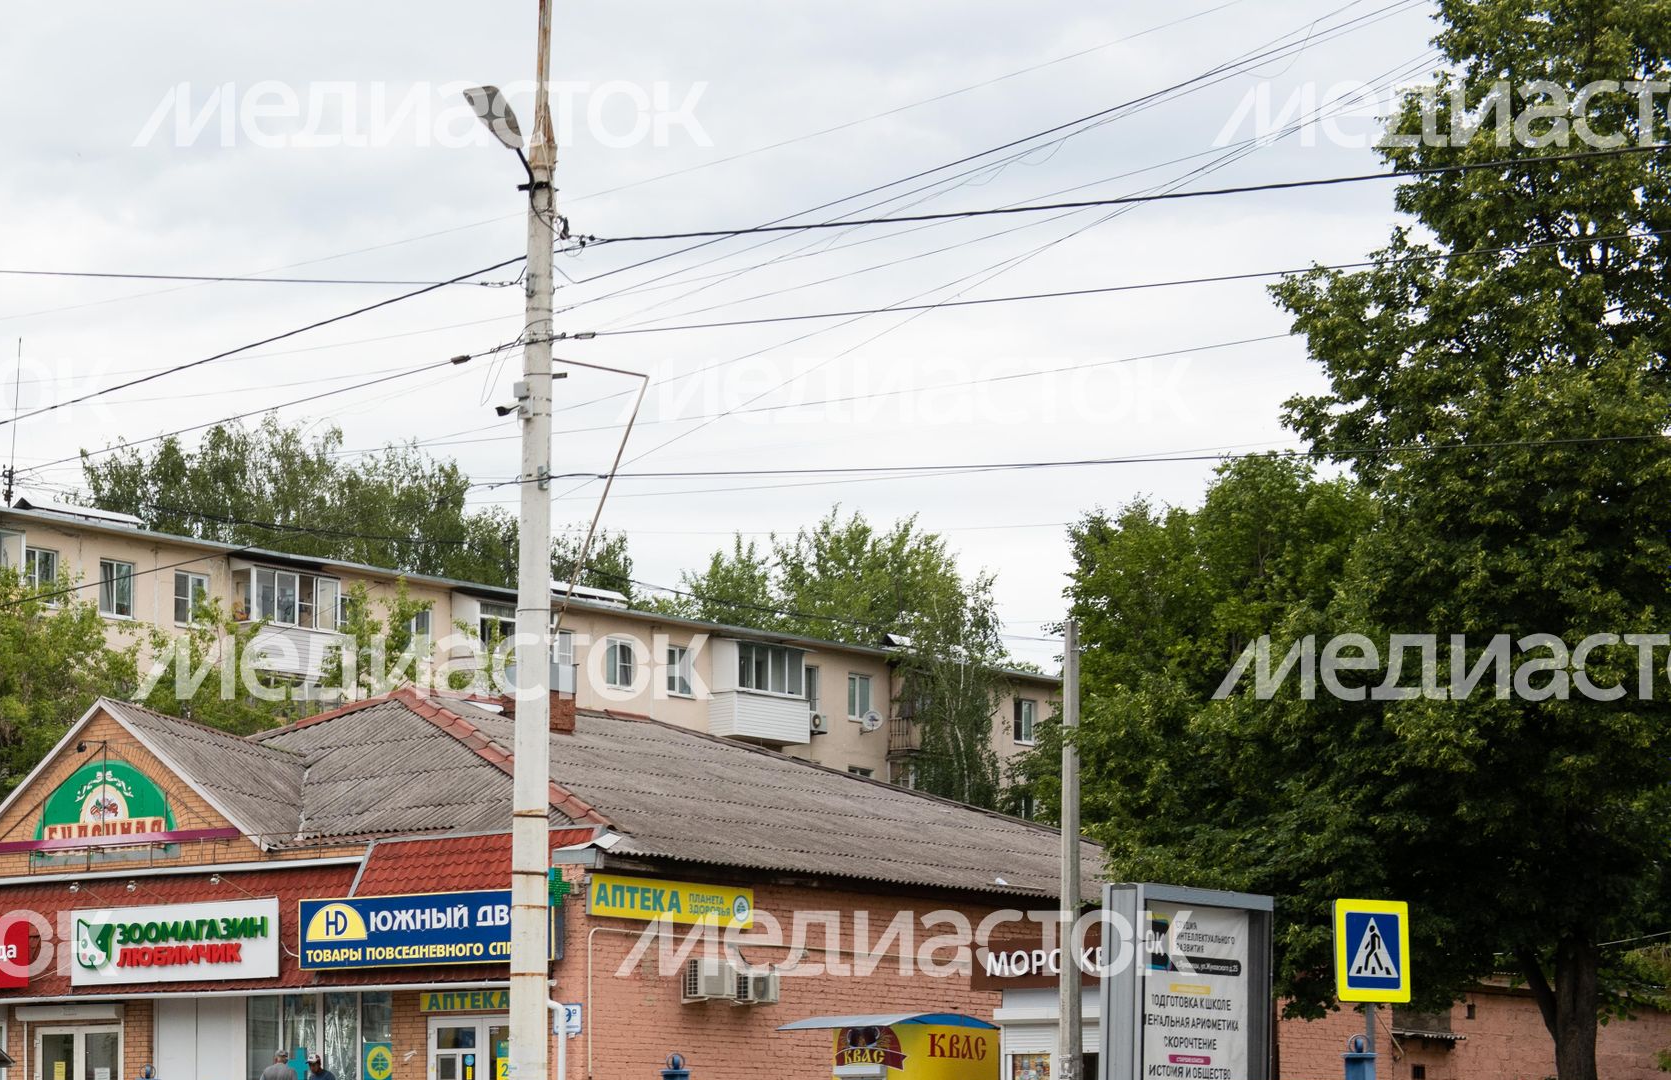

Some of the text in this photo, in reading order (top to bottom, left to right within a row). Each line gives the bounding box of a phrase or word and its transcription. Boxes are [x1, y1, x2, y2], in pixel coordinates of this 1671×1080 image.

[595, 883, 682, 914] АПТЕКА
[688, 893, 725, 906] ПЛАНЕТА
[369, 904, 512, 932] ЮЖНЫЙ ДВ
[688, 905, 731, 917] ЗДОРОВЬЯ
[116, 916, 268, 944] ЗООМАГАЗИН
[117, 943, 242, 967] ЛЮБИМЧИК
[306, 948, 362, 963] ТОВАРЫ
[366, 943, 484, 960] ПОВСЕДНЕВНОГО
[427, 991, 510, 1010] АПТЕКА
[1151, 994, 1232, 1011] ПОДГОТОВКА К ШКОЛЕ
[1191, 1017, 1239, 1031] АРИФМЕТИКА
[928, 1033, 987, 1061] КВАС
[1163, 1035, 1217, 1050] СКОРОЧТЕНИЕ
[843, 1048, 886, 1064] КВАС
[1148, 1064, 1231, 1080] ИСТОРИЯ И ОБЩЕСТВО
